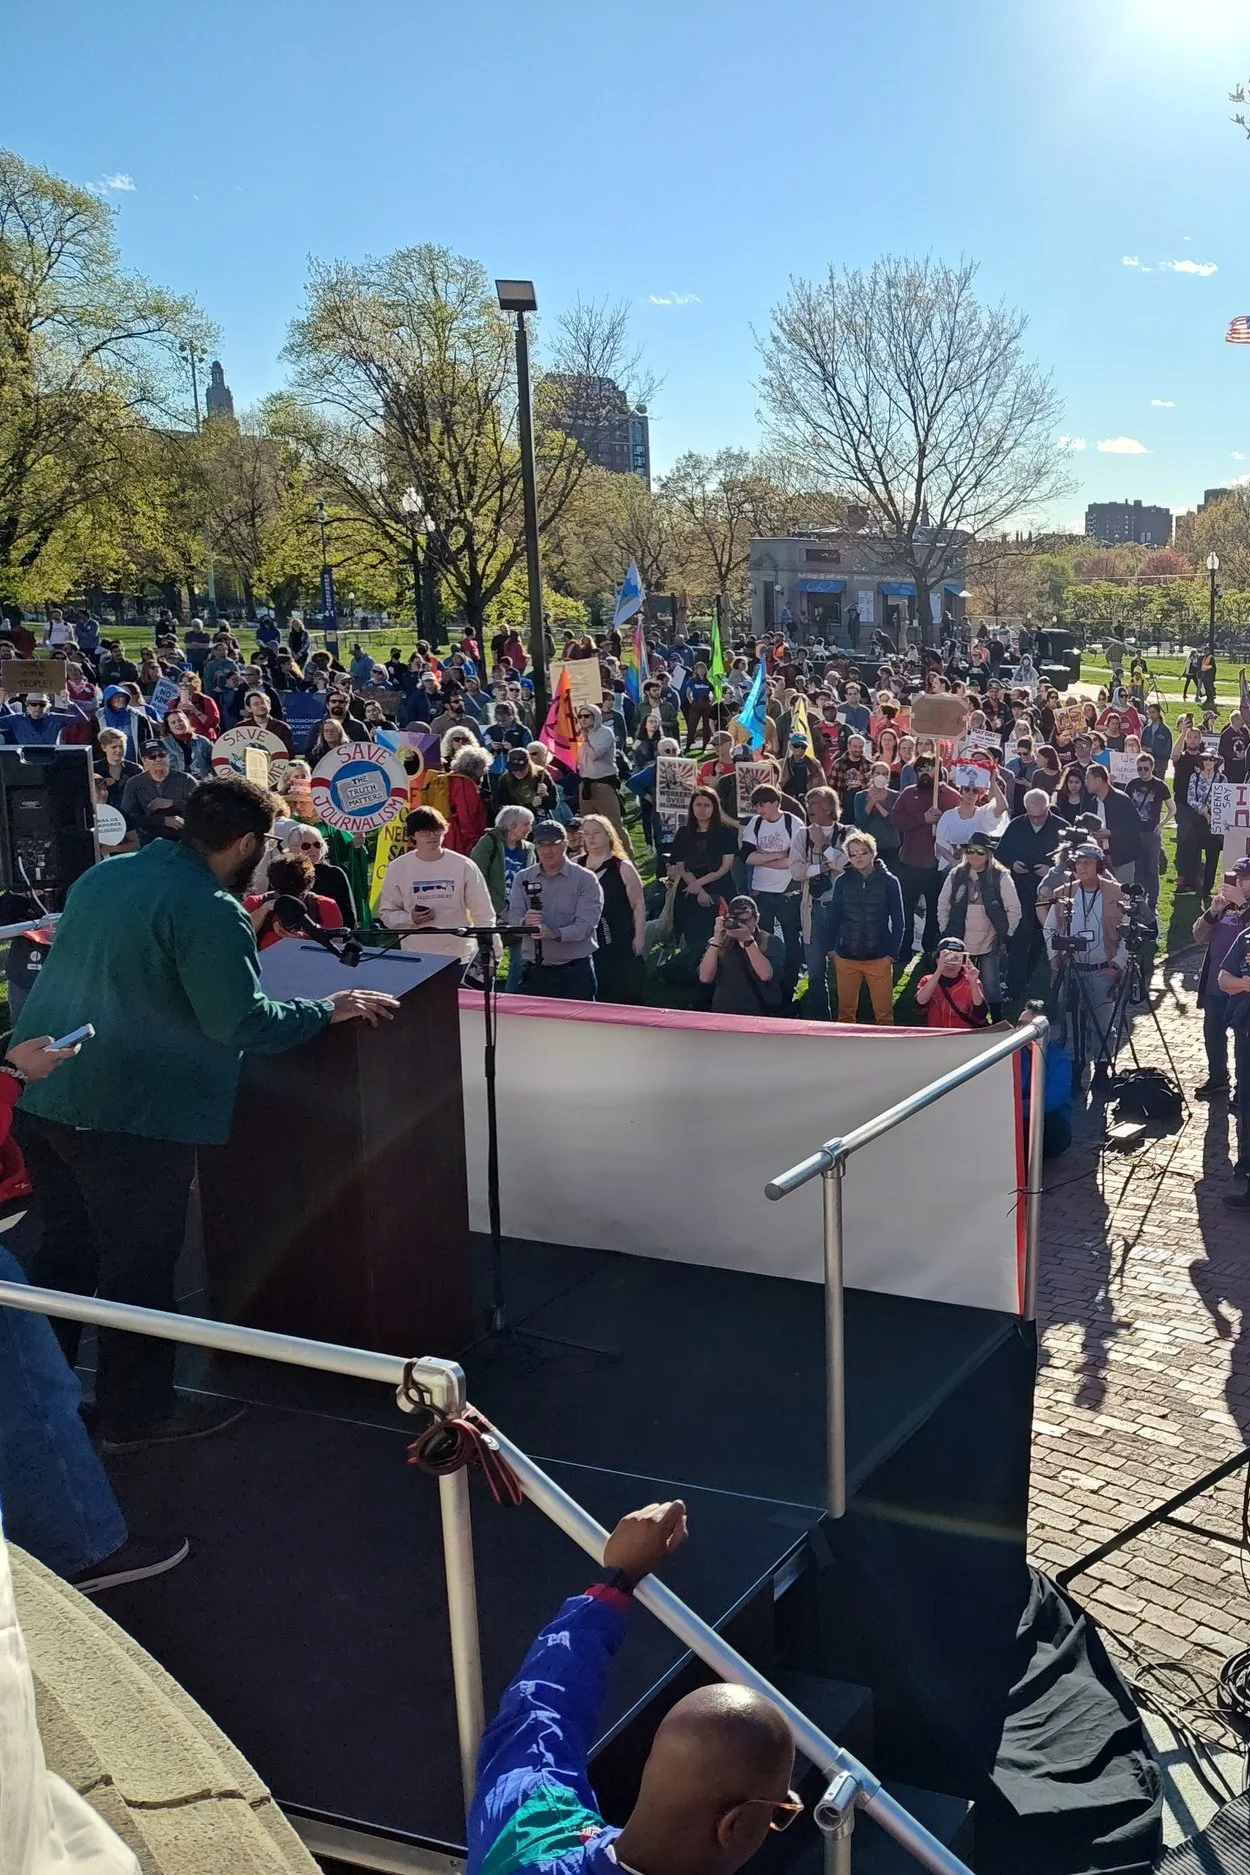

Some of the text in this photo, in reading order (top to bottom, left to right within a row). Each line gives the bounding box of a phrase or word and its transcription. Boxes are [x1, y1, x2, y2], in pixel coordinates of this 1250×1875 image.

[160, 688, 172, 698] NO
[222, 728, 268, 746] SAVE
[336, 743, 391, 766] SAVE
[352, 776, 368, 785] THE
[348, 784, 376, 798] TRUTH
[348, 792, 382, 806] MATTERS
[1222, 788, 1232, 808] SAY
[313, 796, 403, 830] JOURNALISM
[1212, 784, 1223, 834] STUDENTS
